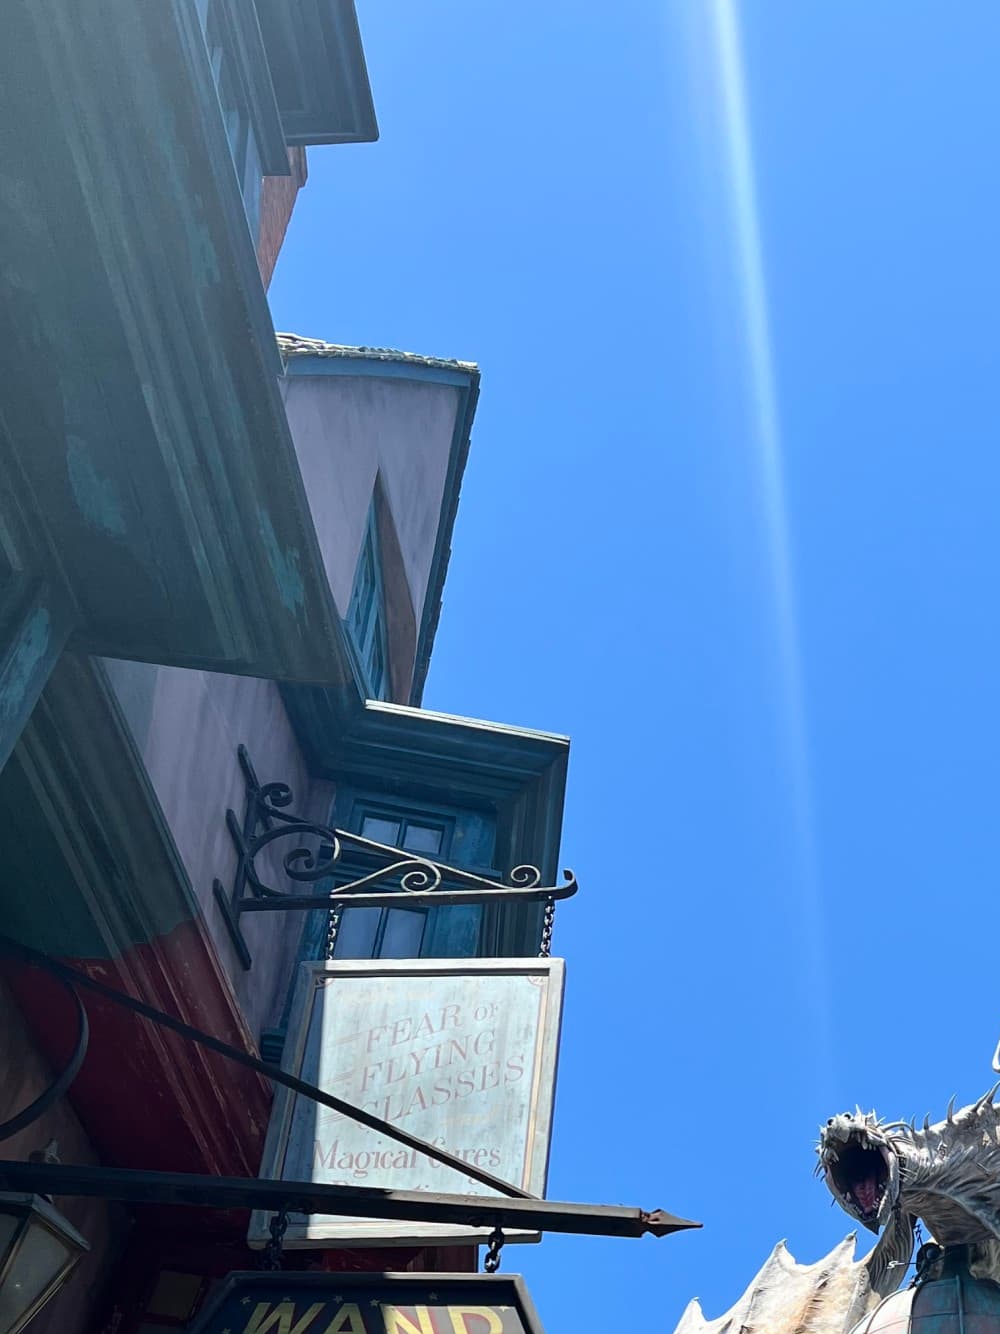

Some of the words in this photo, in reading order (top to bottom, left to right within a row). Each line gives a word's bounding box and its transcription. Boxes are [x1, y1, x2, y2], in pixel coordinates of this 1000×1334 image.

[366, 1004, 466, 1053] FEAR
[474, 1003, 499, 1021] OF
[360, 1029, 497, 1092] FLYING
[313, 1139, 417, 1179] Magical
